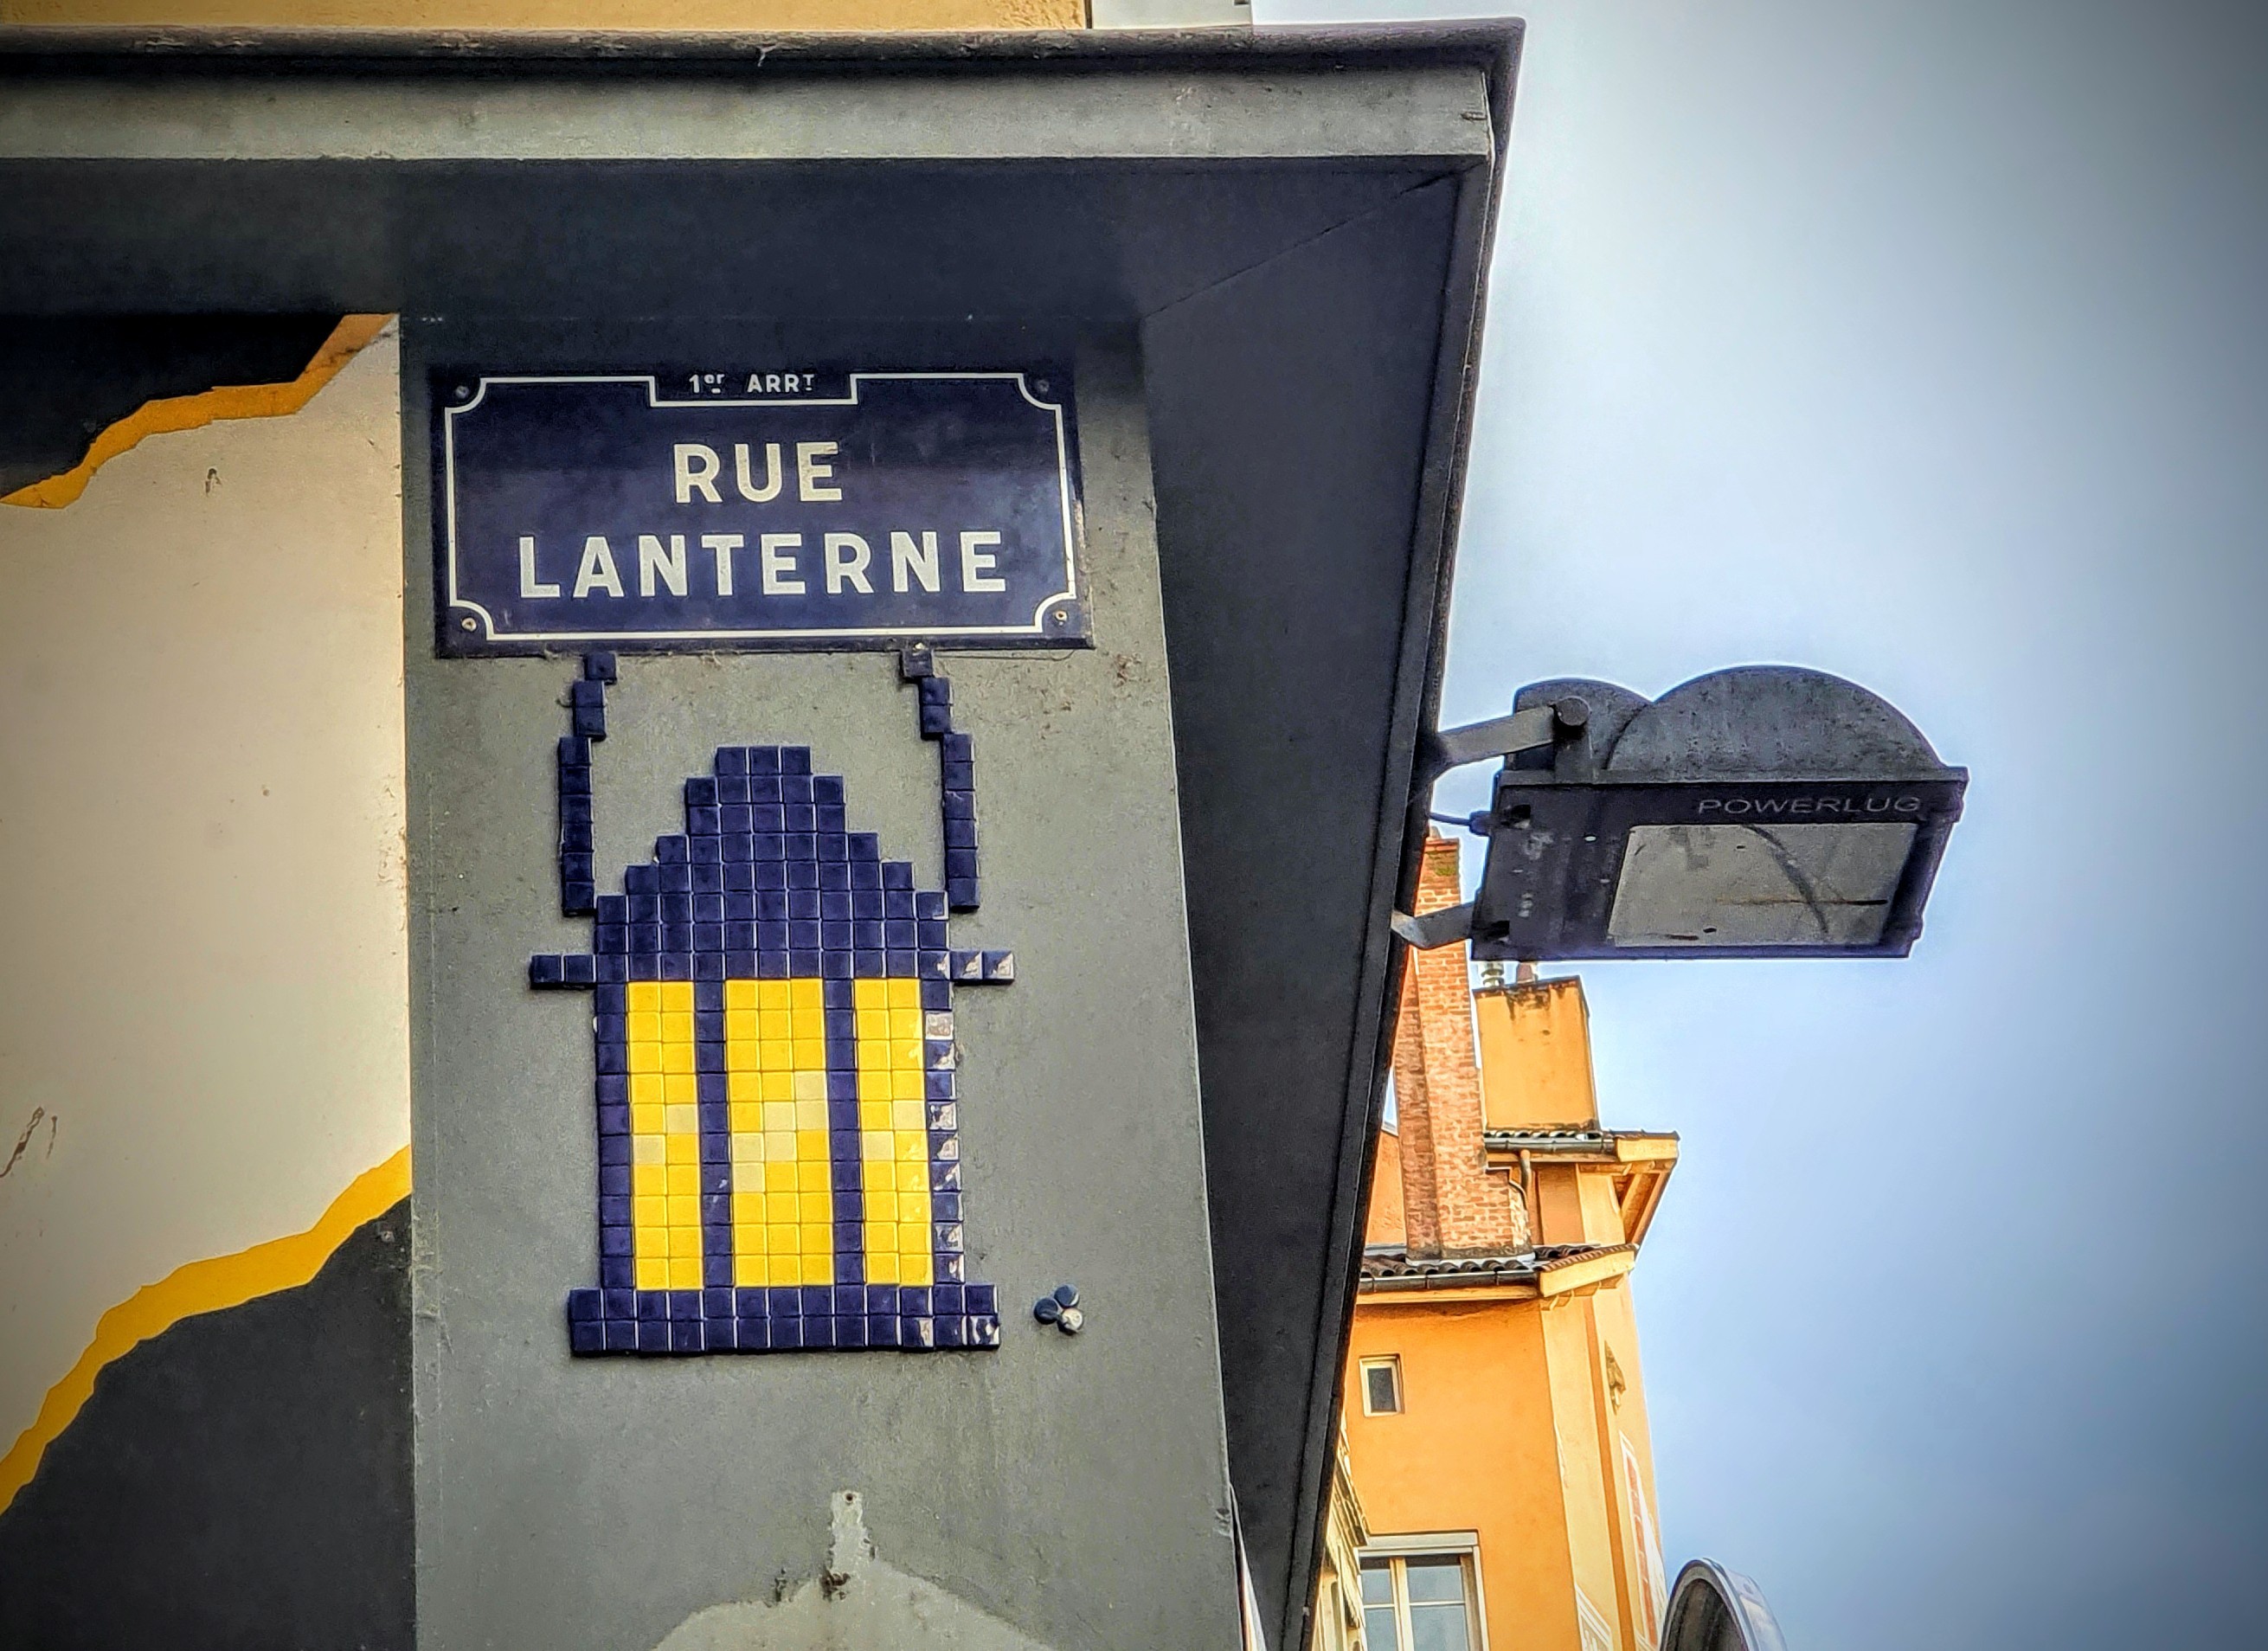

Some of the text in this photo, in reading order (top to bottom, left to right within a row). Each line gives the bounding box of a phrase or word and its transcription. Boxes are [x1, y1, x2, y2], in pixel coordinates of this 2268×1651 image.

[689, 374, 725, 394] 1er
[673, 441, 843, 504] RUE
[519, 530, 1006, 599] LANTERNE
[1698, 797, 1922, 814] POWERLUG
